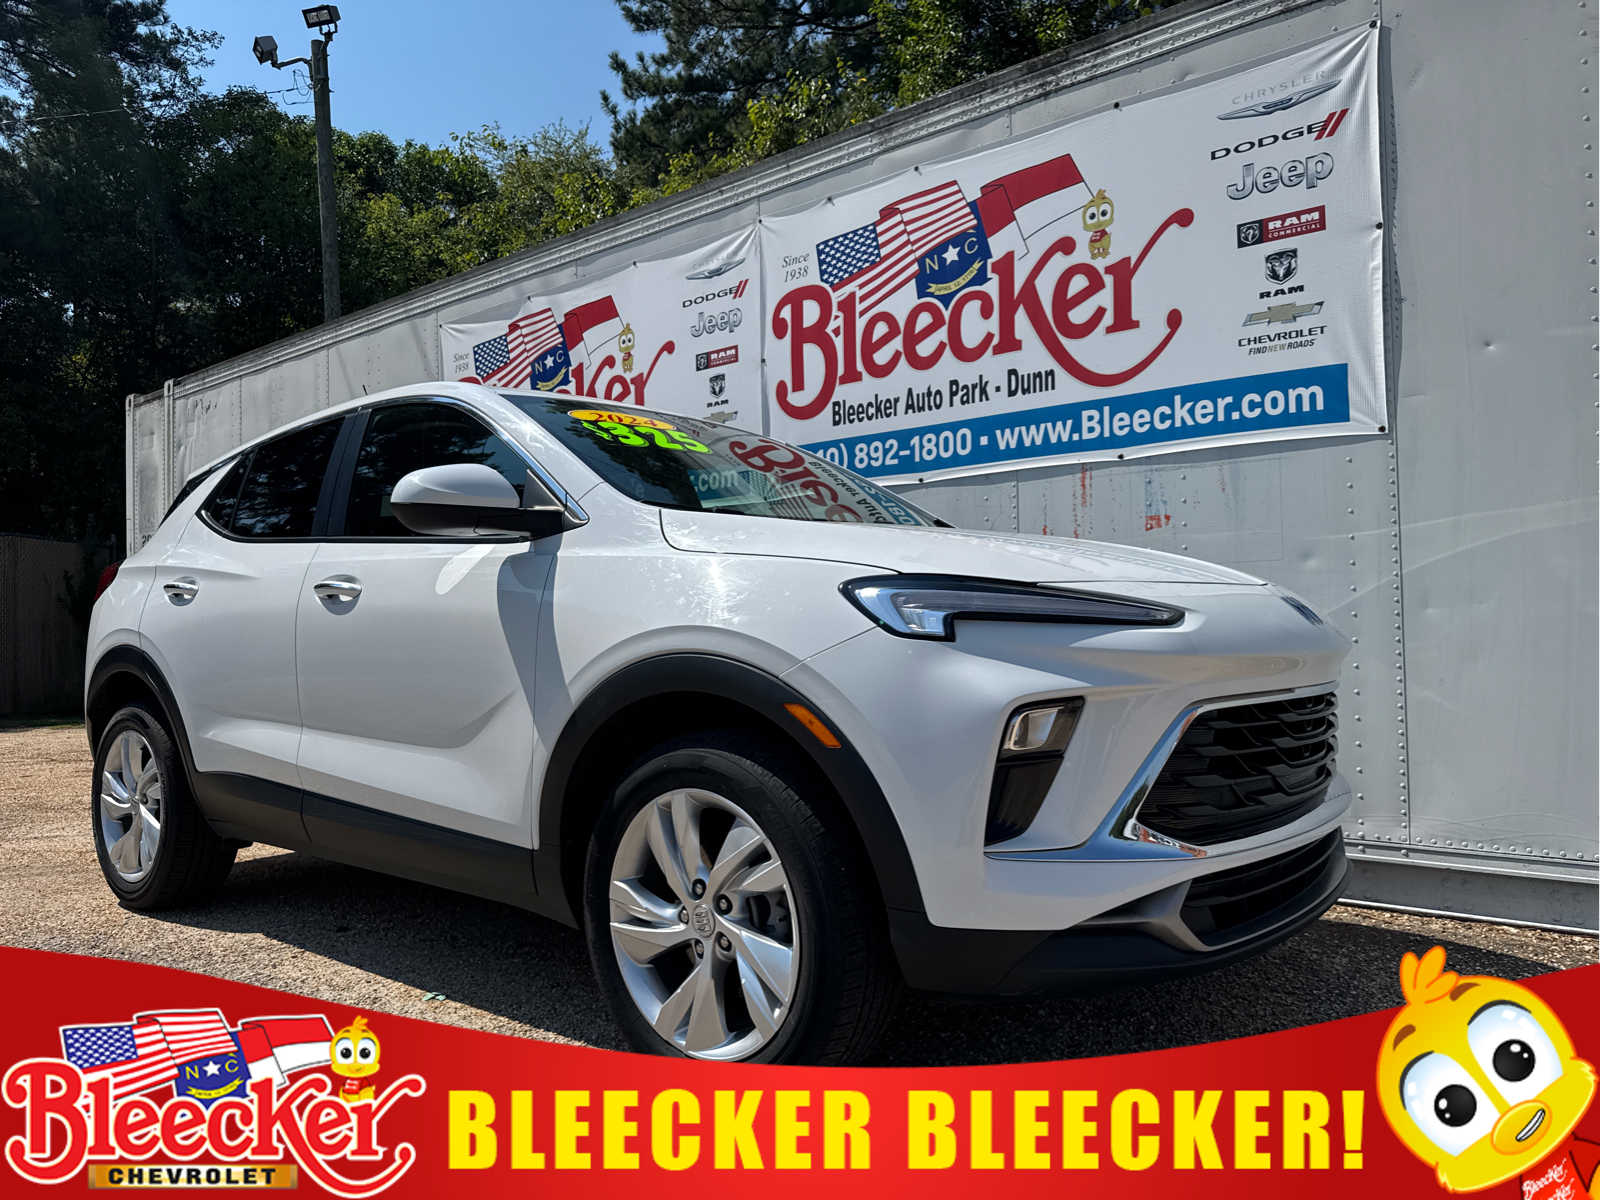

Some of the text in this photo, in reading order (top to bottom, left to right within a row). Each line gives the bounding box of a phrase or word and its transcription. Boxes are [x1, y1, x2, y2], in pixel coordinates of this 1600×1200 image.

[1231, 70, 1326, 105] CHRYSLER
[1210, 119, 1330, 161] DODGE
[1226, 151, 1334, 200] Jeep
[1267, 210, 1320, 231] RAM
[1268, 223, 1321, 239] COMMERCIAL
[782, 252, 810, 268] Since
[784, 265, 809, 283] 1938
[682, 284, 740, 308] DODGE
[1258, 284, 1305, 300] RAM
[690, 307, 742, 338] Jeep
[772, 207, 1195, 421] Bleecker
[1238, 325, 1328, 348] CHEVROLET
[710, 348, 736, 360] RAM
[706, 399, 729, 408] RAM
[831, 393, 900, 427] Bleecker
[904, 387, 943, 415] Auto
[949, 374, 990, 408] Park
[1006, 368, 1056, 398] Dunn
[854, 428, 973, 470] 892-1800
[995, 384, 1324, 450] www.Bleecker.com
